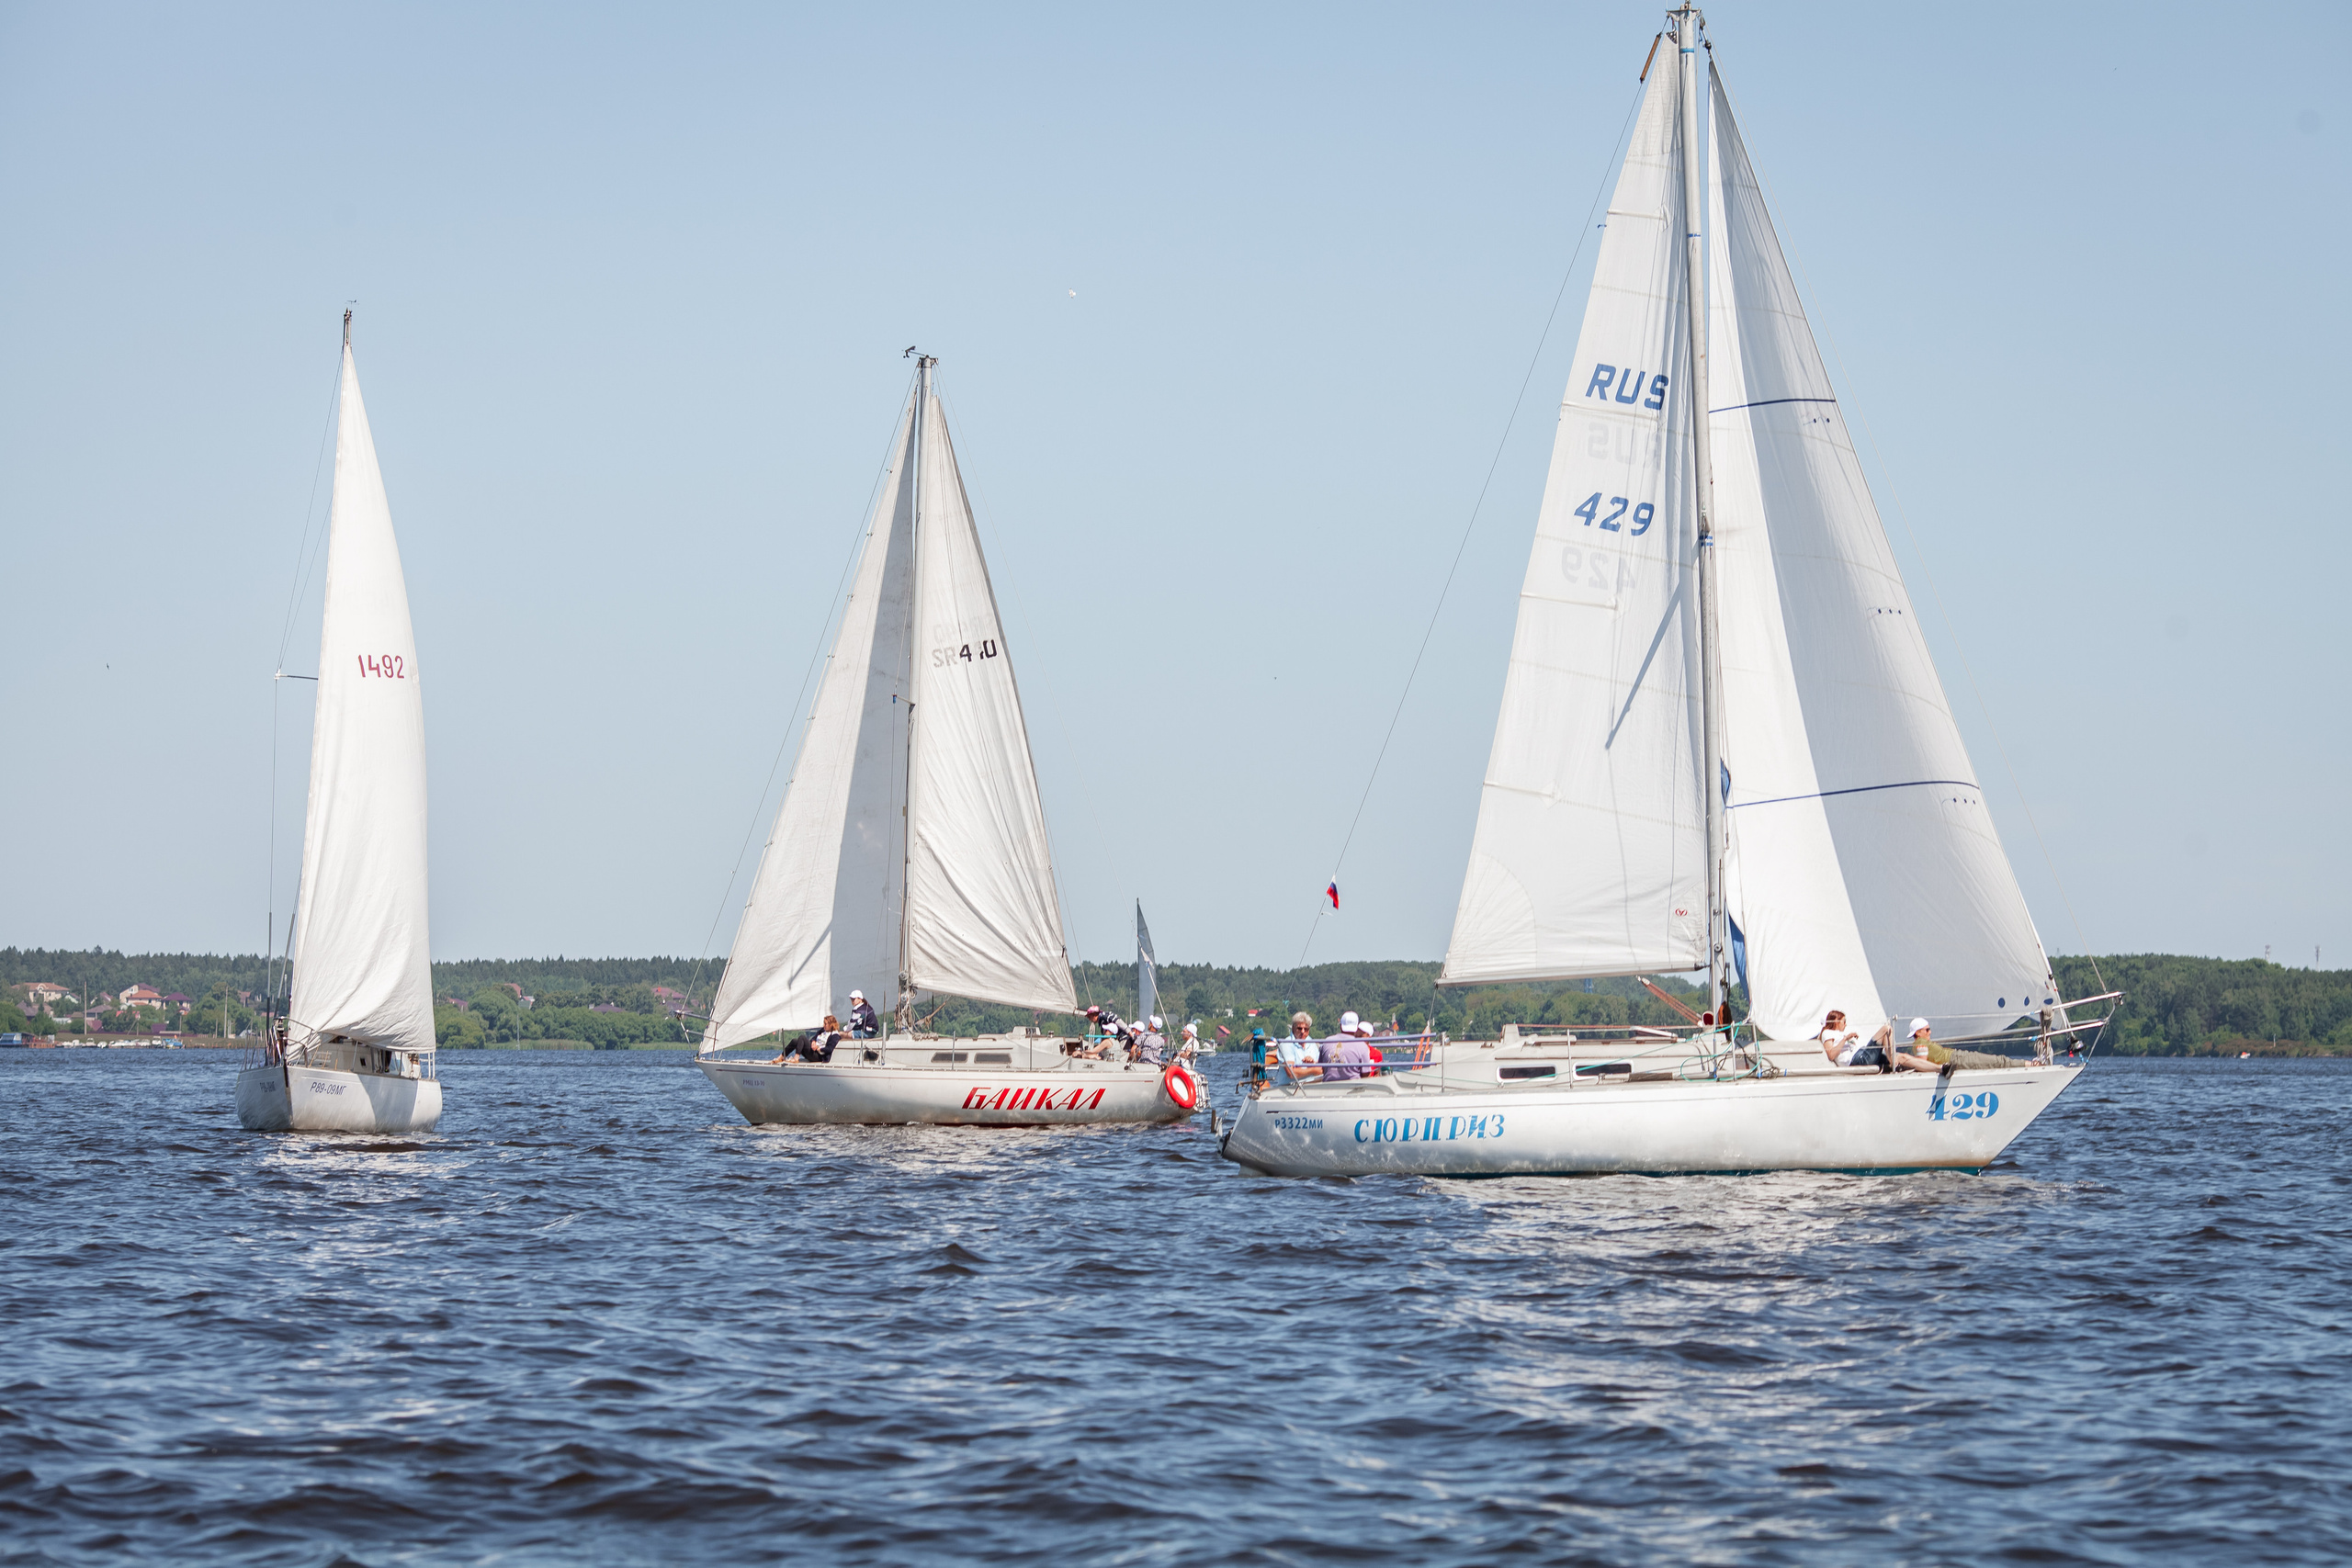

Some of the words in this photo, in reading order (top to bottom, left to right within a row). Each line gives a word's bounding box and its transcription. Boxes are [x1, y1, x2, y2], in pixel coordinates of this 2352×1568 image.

[1585, 363, 1669, 411] RUS
[1574, 491, 1655, 536] 429
[358, 654, 404, 679] 1492
[1925, 1091, 1999, 1122] 429
[1354, 1114, 1505, 1144] СЮРПРИЗ
